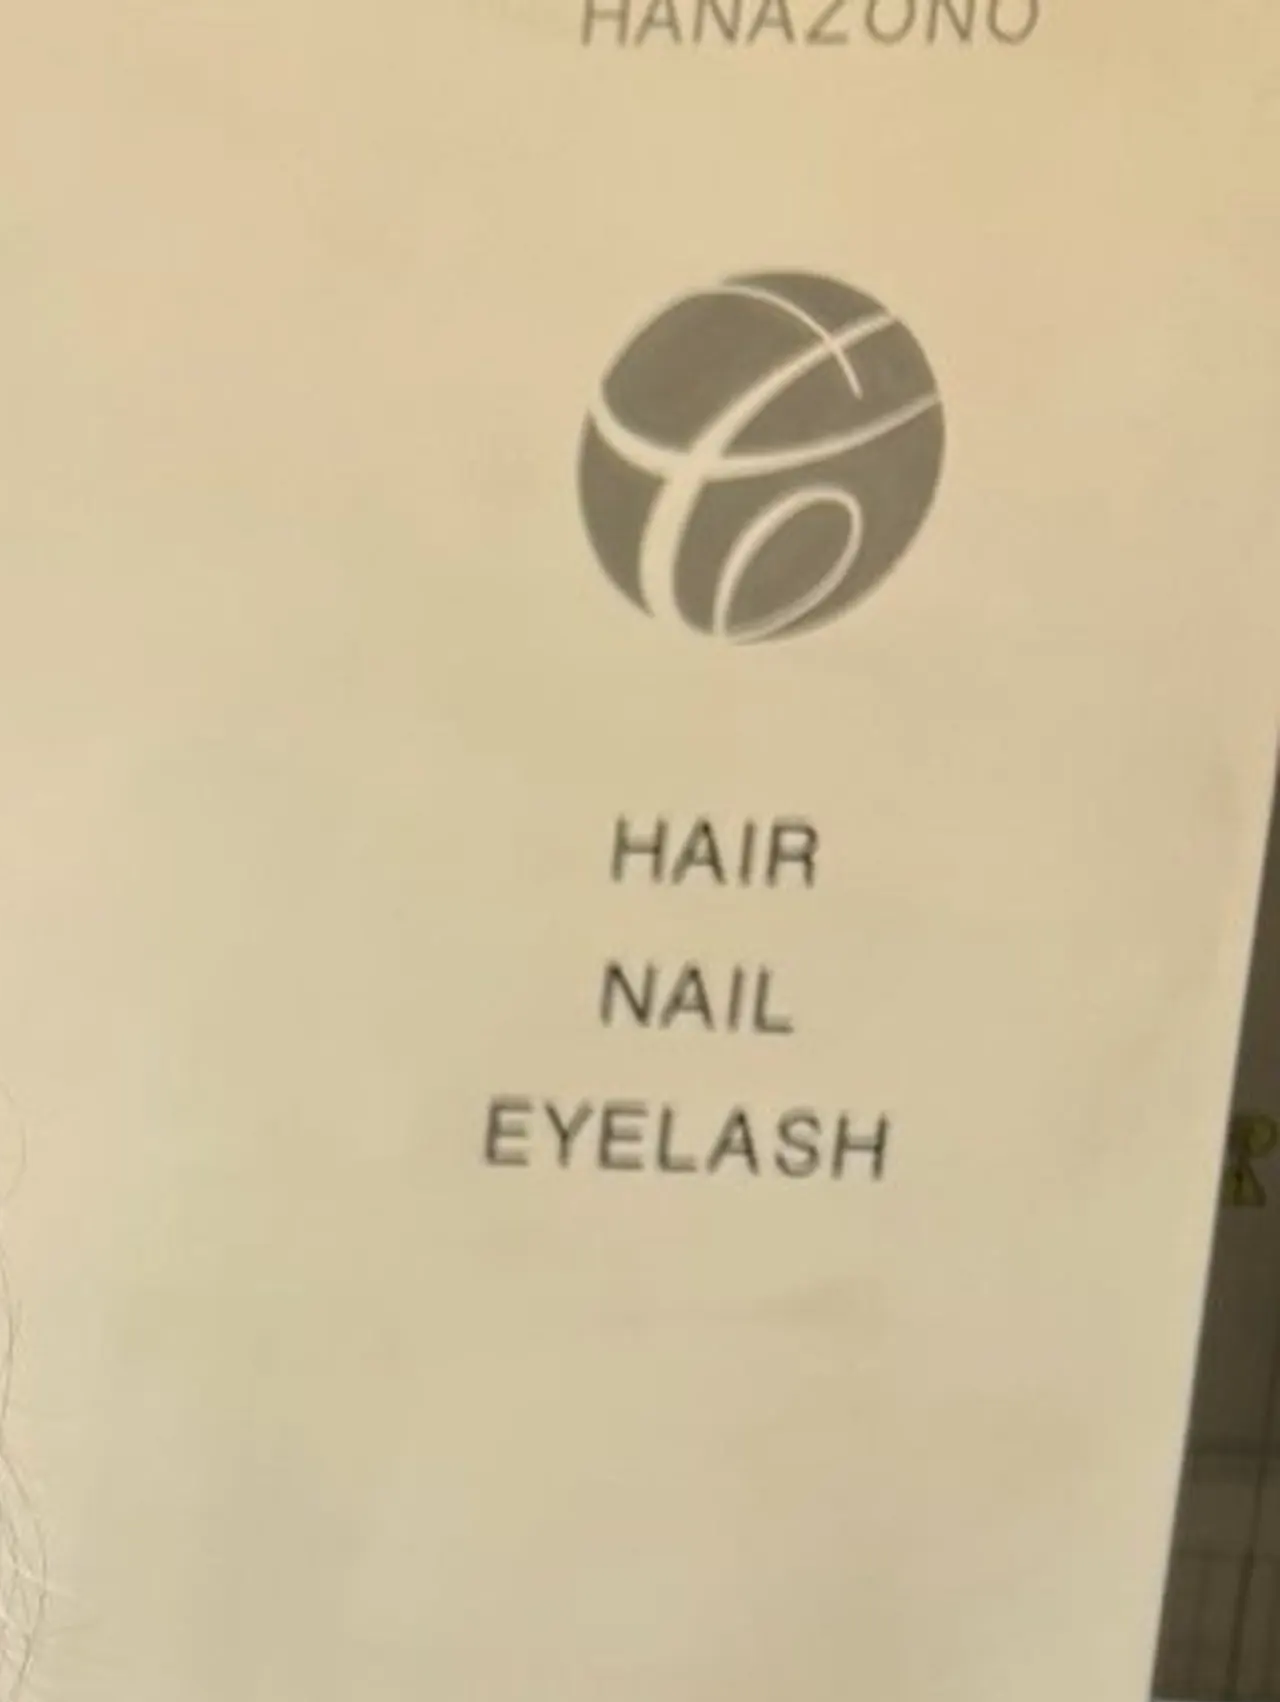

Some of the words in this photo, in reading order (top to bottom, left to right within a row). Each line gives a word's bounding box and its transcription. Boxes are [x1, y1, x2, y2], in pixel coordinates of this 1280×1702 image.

[580, 0, 1041, 47] HANAZONO
[610, 814, 821, 889] HAIR
[598, 959, 795, 1036] NAIL
[481, 1094, 892, 1182] EYELASH
